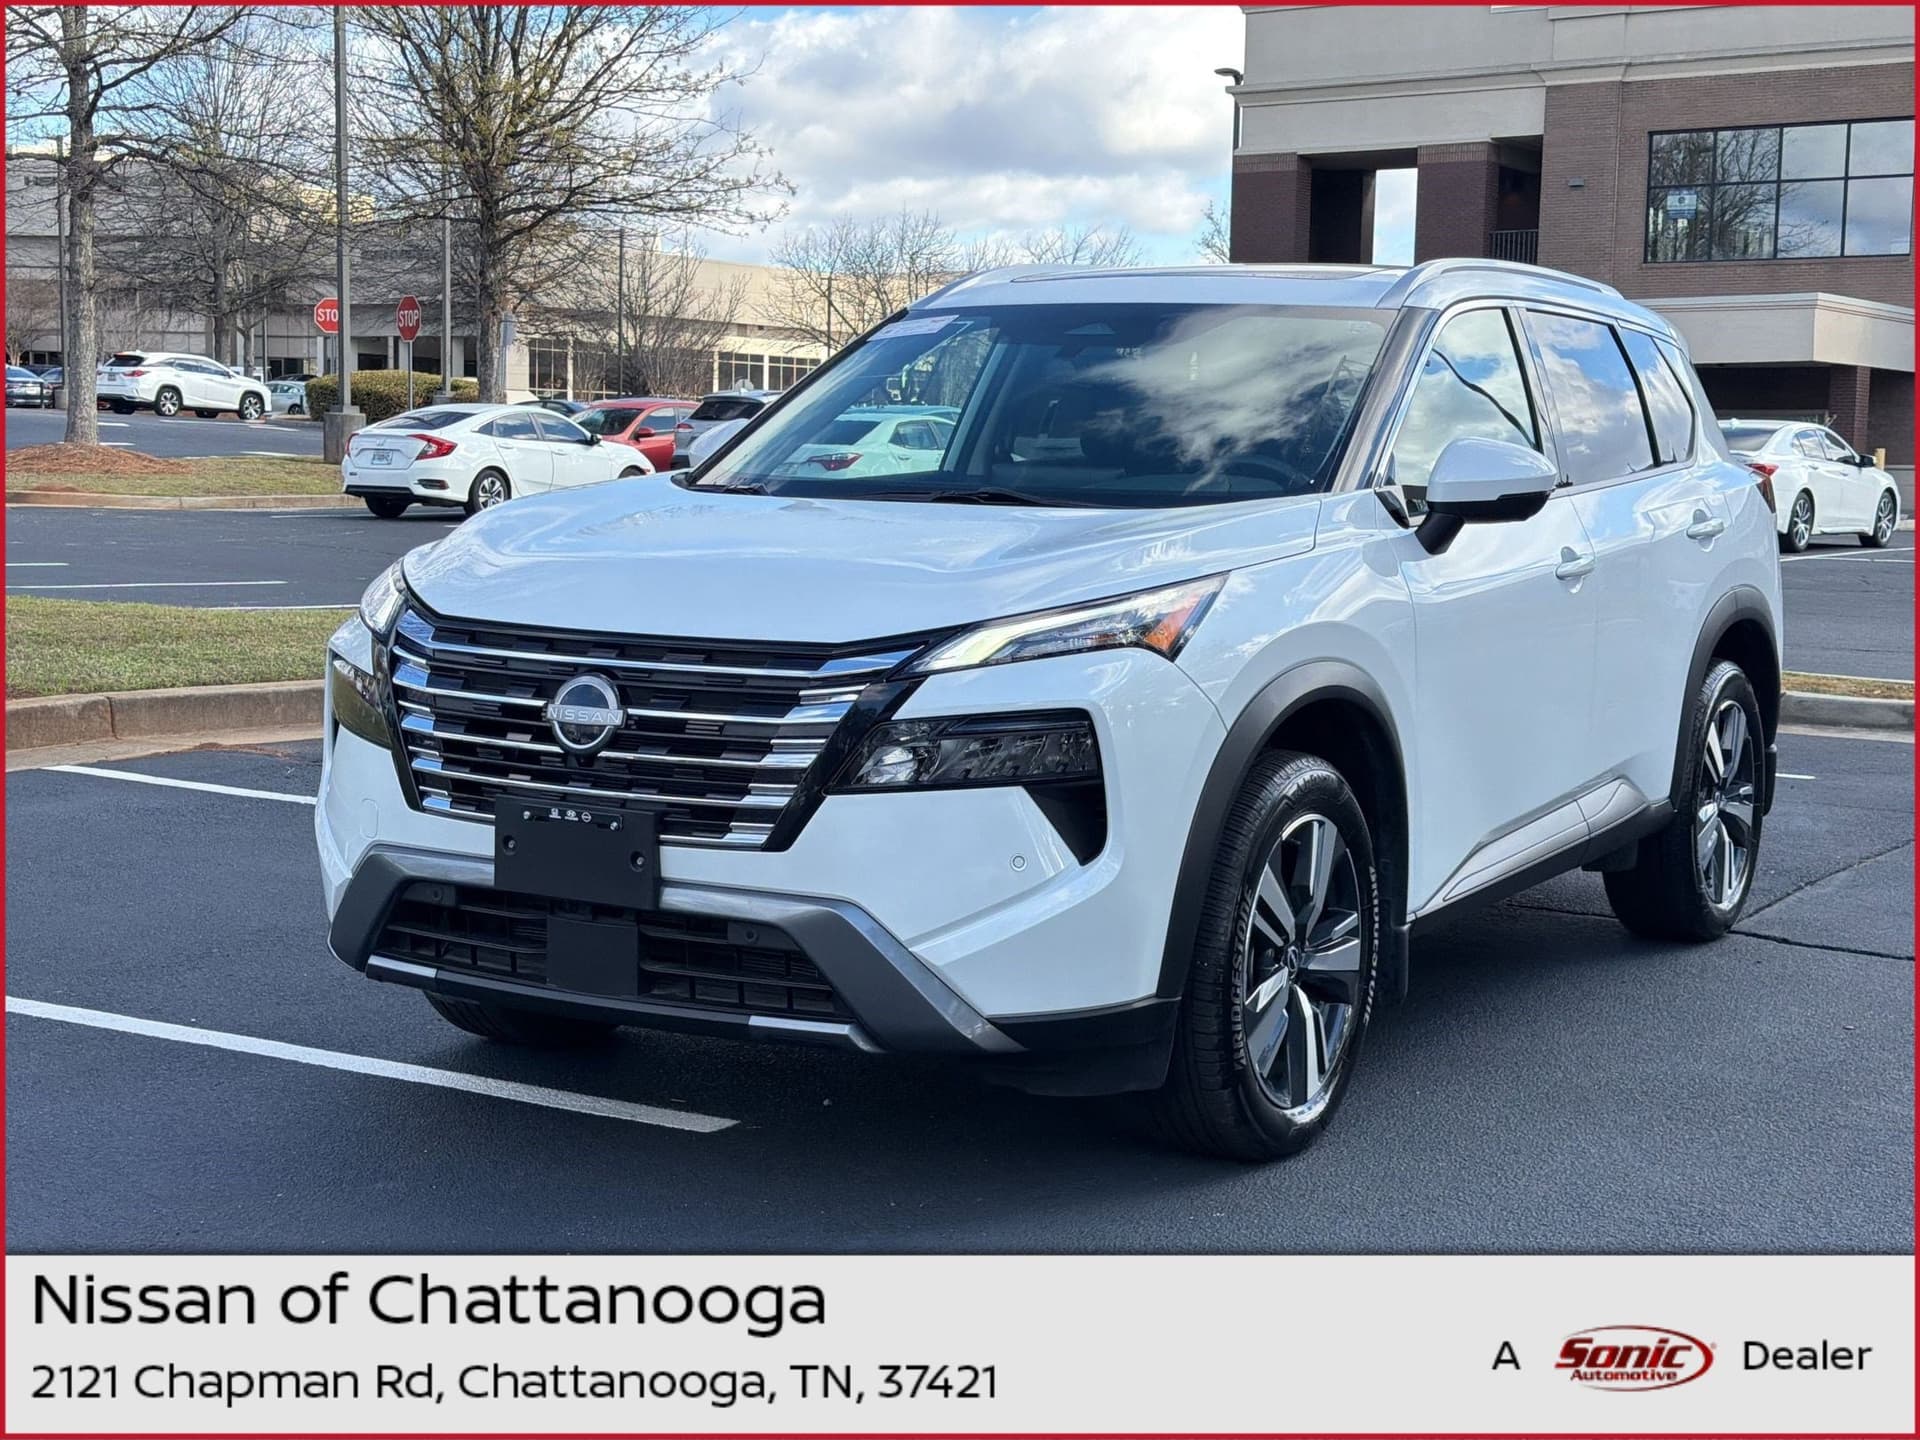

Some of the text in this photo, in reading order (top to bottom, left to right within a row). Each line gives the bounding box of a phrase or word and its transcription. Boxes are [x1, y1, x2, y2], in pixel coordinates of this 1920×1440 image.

[317, 309, 339, 322] STO
[399, 310, 419, 327] STOP
[550, 706, 620, 723] NISSAN
[1231, 884, 1253, 1070] BRIDGESTONE
